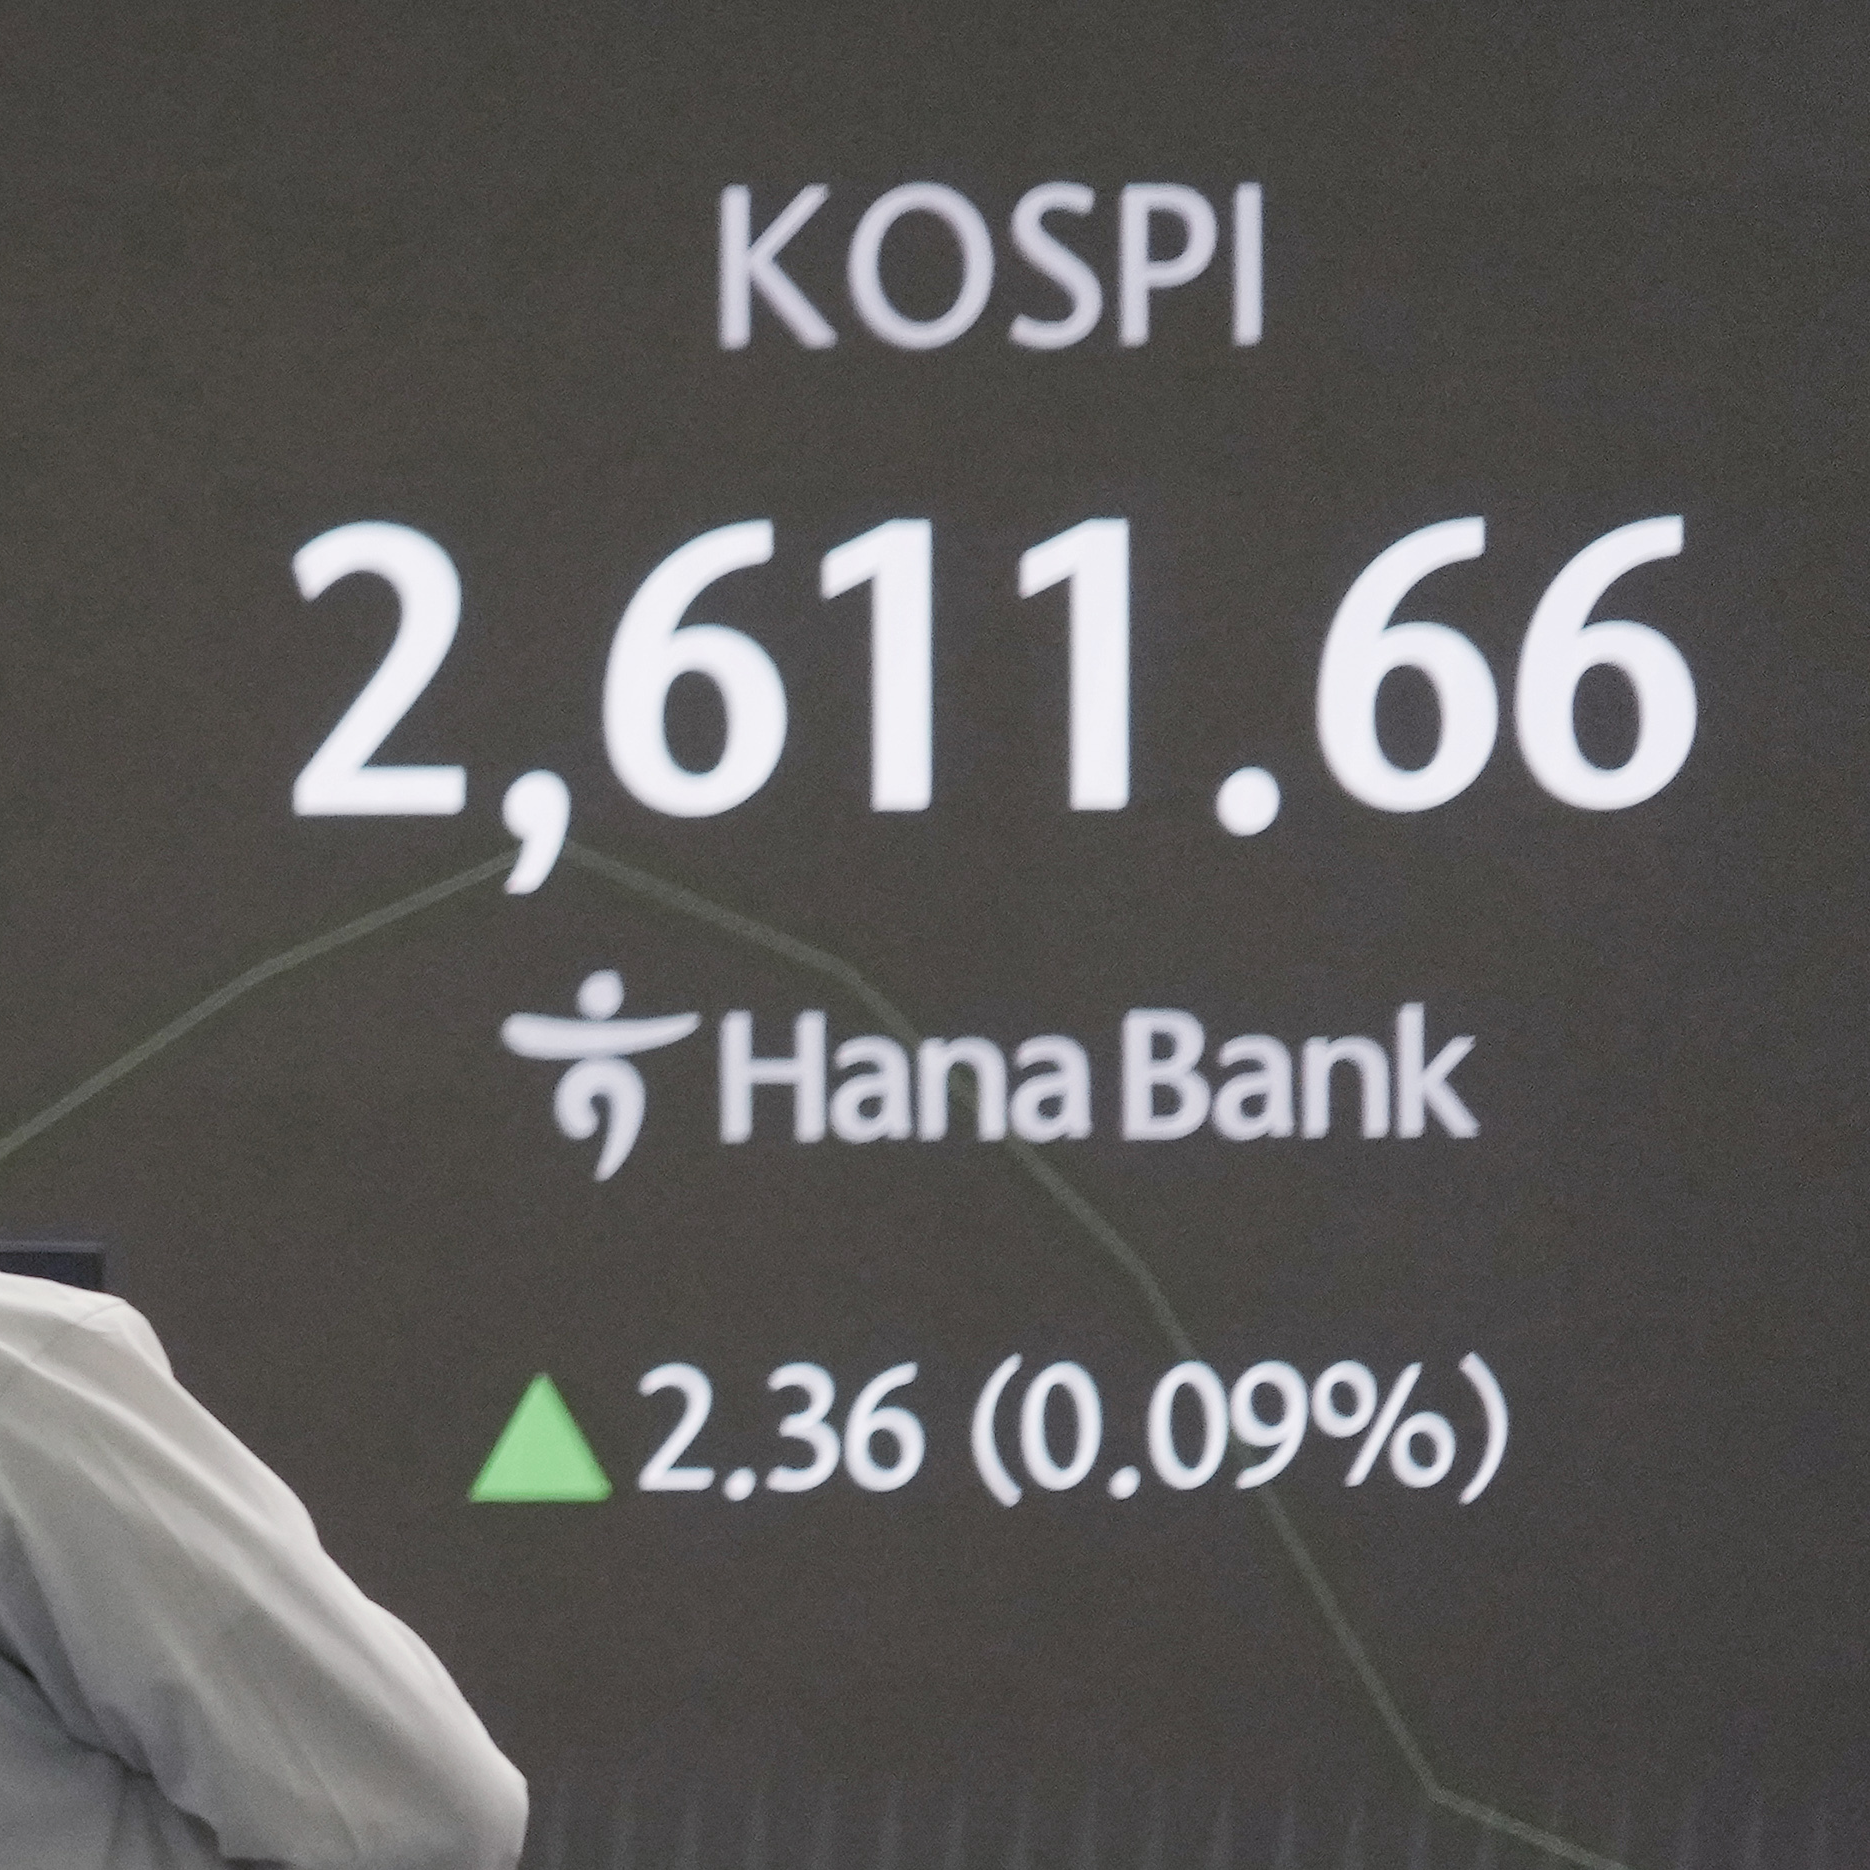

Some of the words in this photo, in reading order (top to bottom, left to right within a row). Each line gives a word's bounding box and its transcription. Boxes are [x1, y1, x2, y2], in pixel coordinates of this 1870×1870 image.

[718, 180, 1264, 351] KOSPI
[292, 516, 1698, 894] 2,611.66
[637, 1361, 927, 1503] 2.36
[970, 1352, 1510, 1507] (0.09%)
